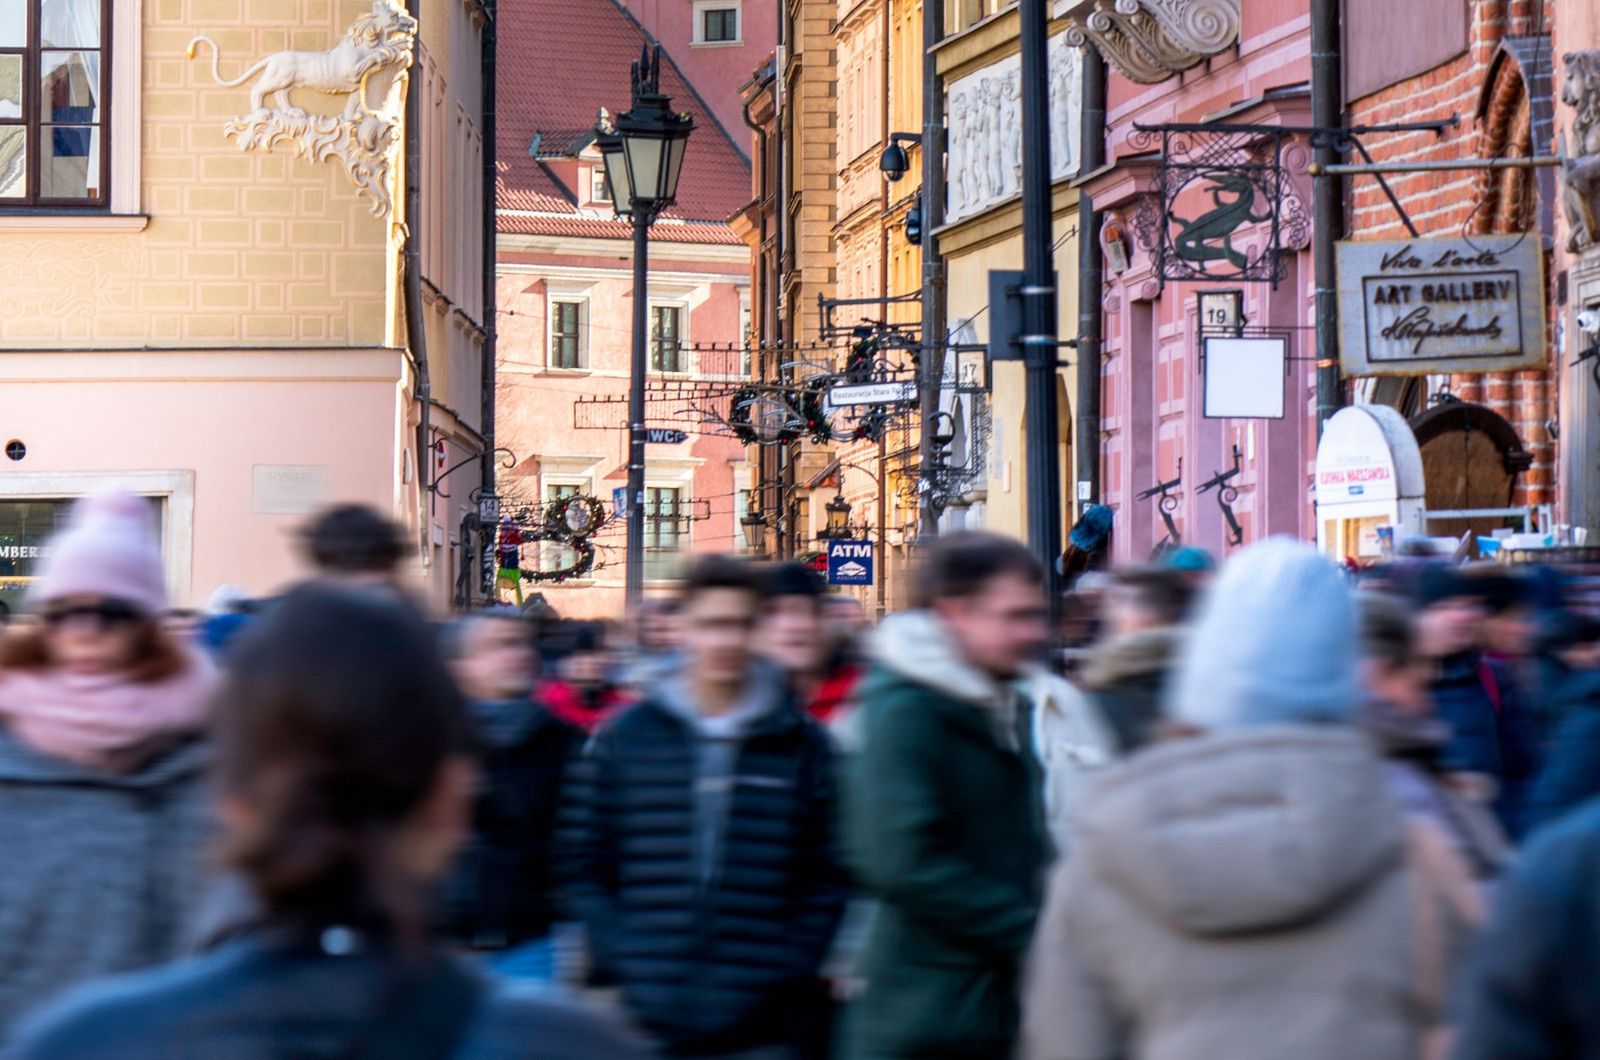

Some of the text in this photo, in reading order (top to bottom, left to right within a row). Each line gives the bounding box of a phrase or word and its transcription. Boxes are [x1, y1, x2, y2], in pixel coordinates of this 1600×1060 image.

[1374, 280, 1511, 304] ART GALLERY
[1207, 308, 1226, 324] 19
[963, 363, 977, 377] 17
[650, 429, 674, 443] WC
[484, 499, 496, 511] 14
[831, 544, 872, 558] ATM
